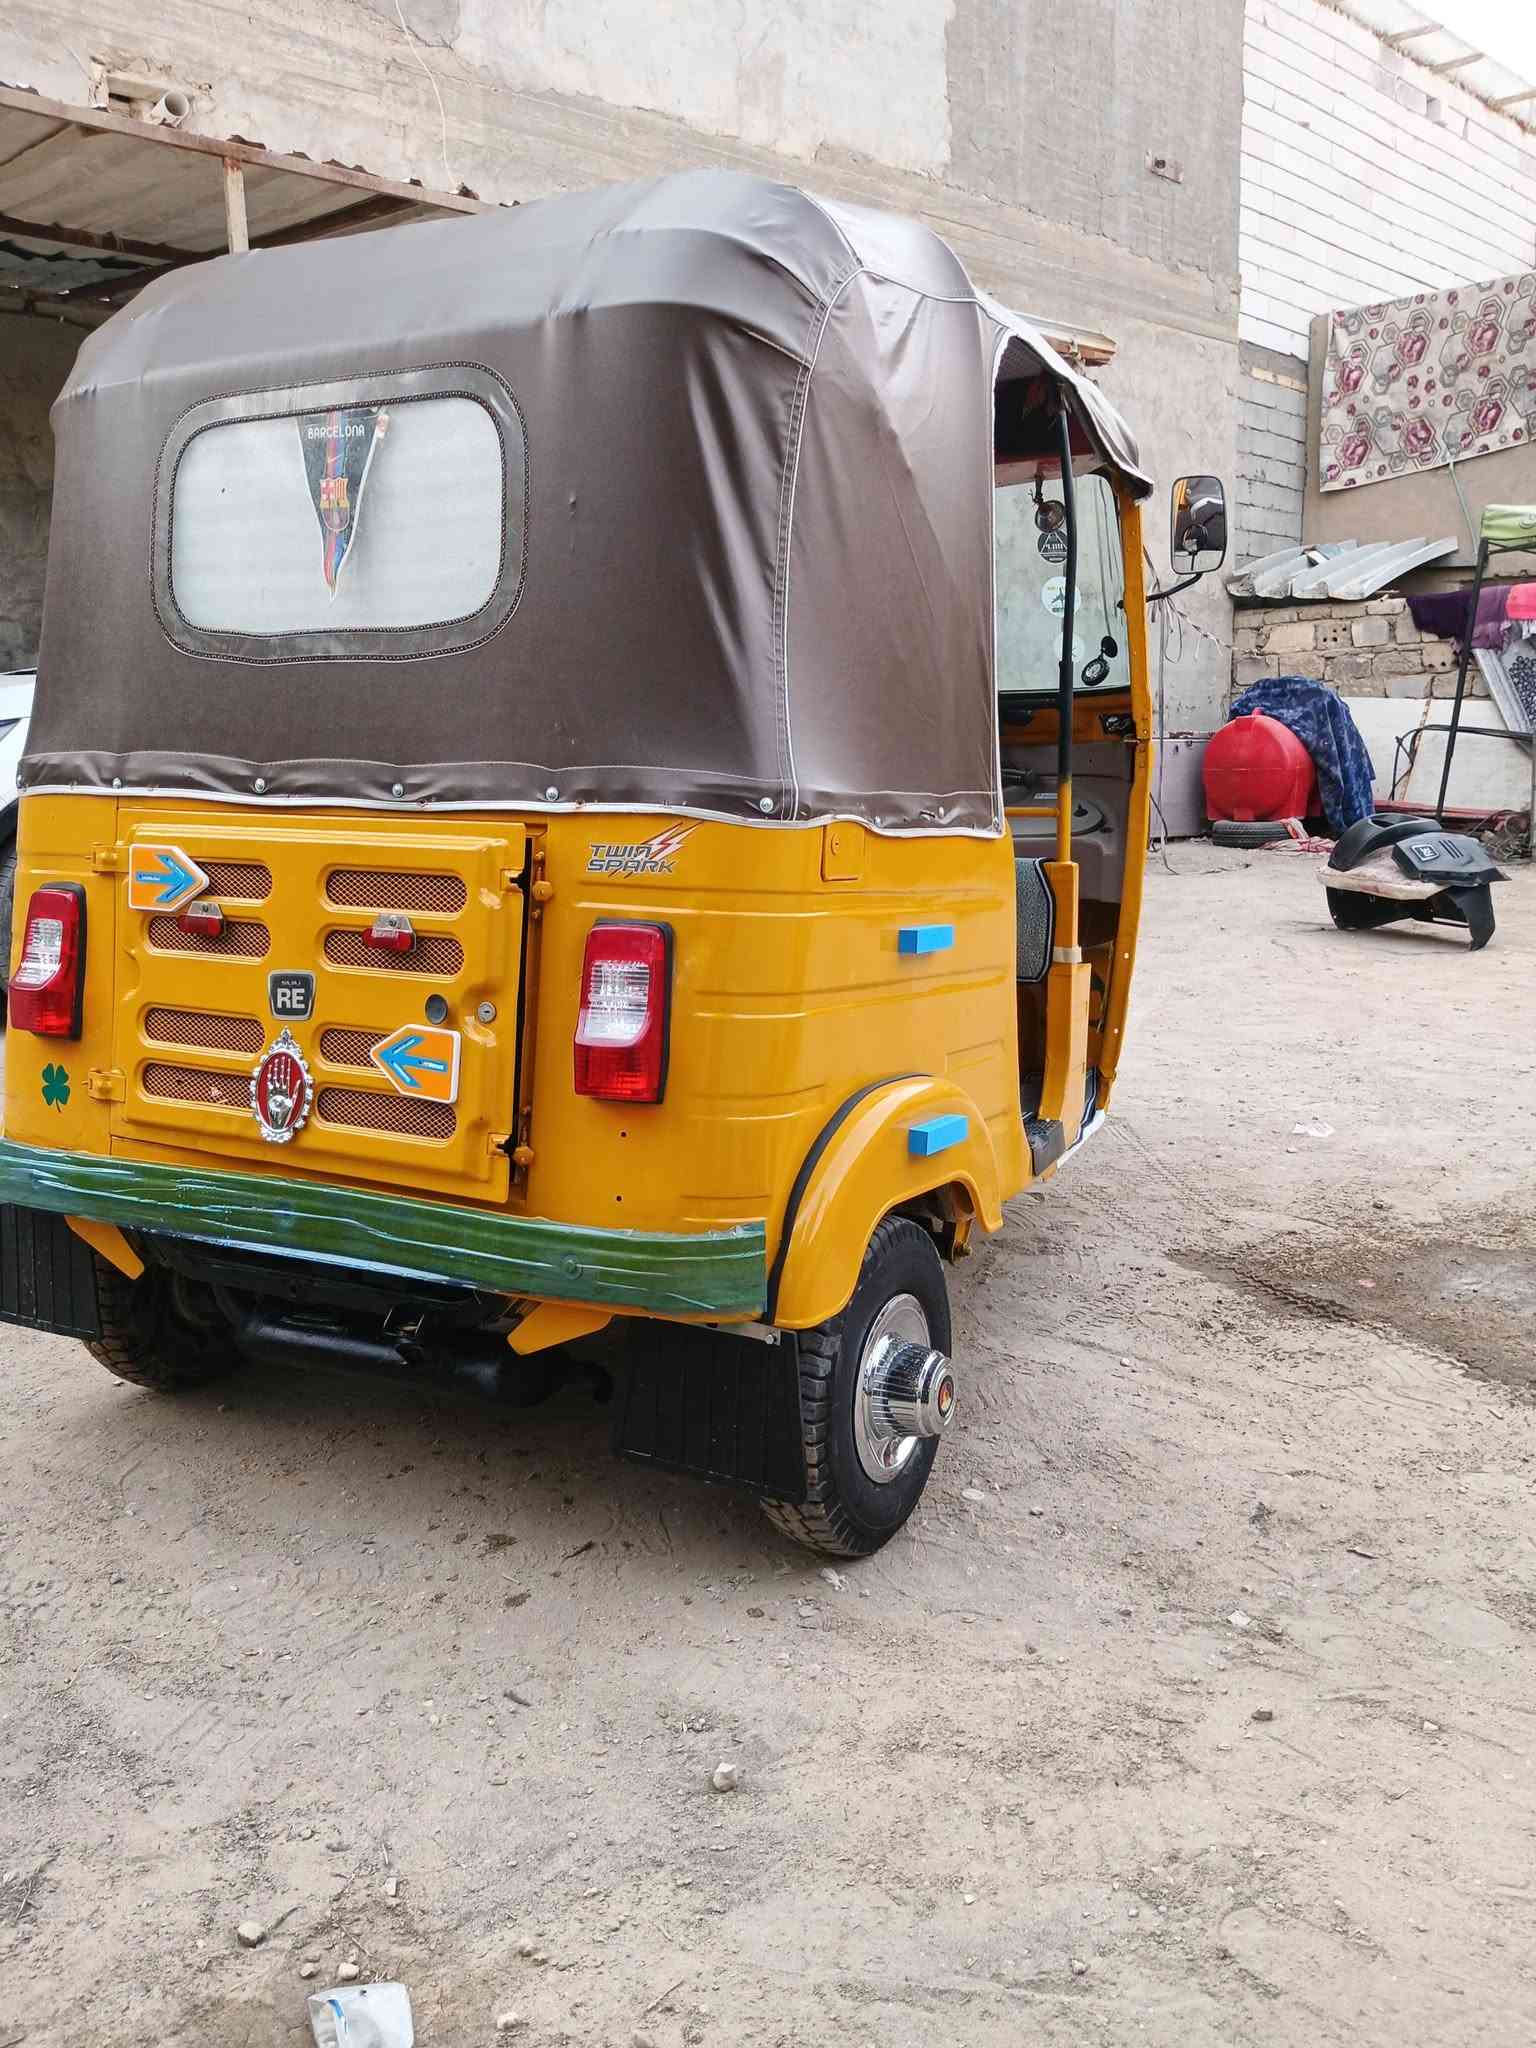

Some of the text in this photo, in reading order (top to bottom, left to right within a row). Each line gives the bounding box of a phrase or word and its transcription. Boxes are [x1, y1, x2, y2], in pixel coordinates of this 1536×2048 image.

[307, 423, 365, 440] BARCELONA
[590, 843, 652, 858] TWIN
[587, 859, 677, 873] SPARK
[276, 987, 306, 1009] RE
